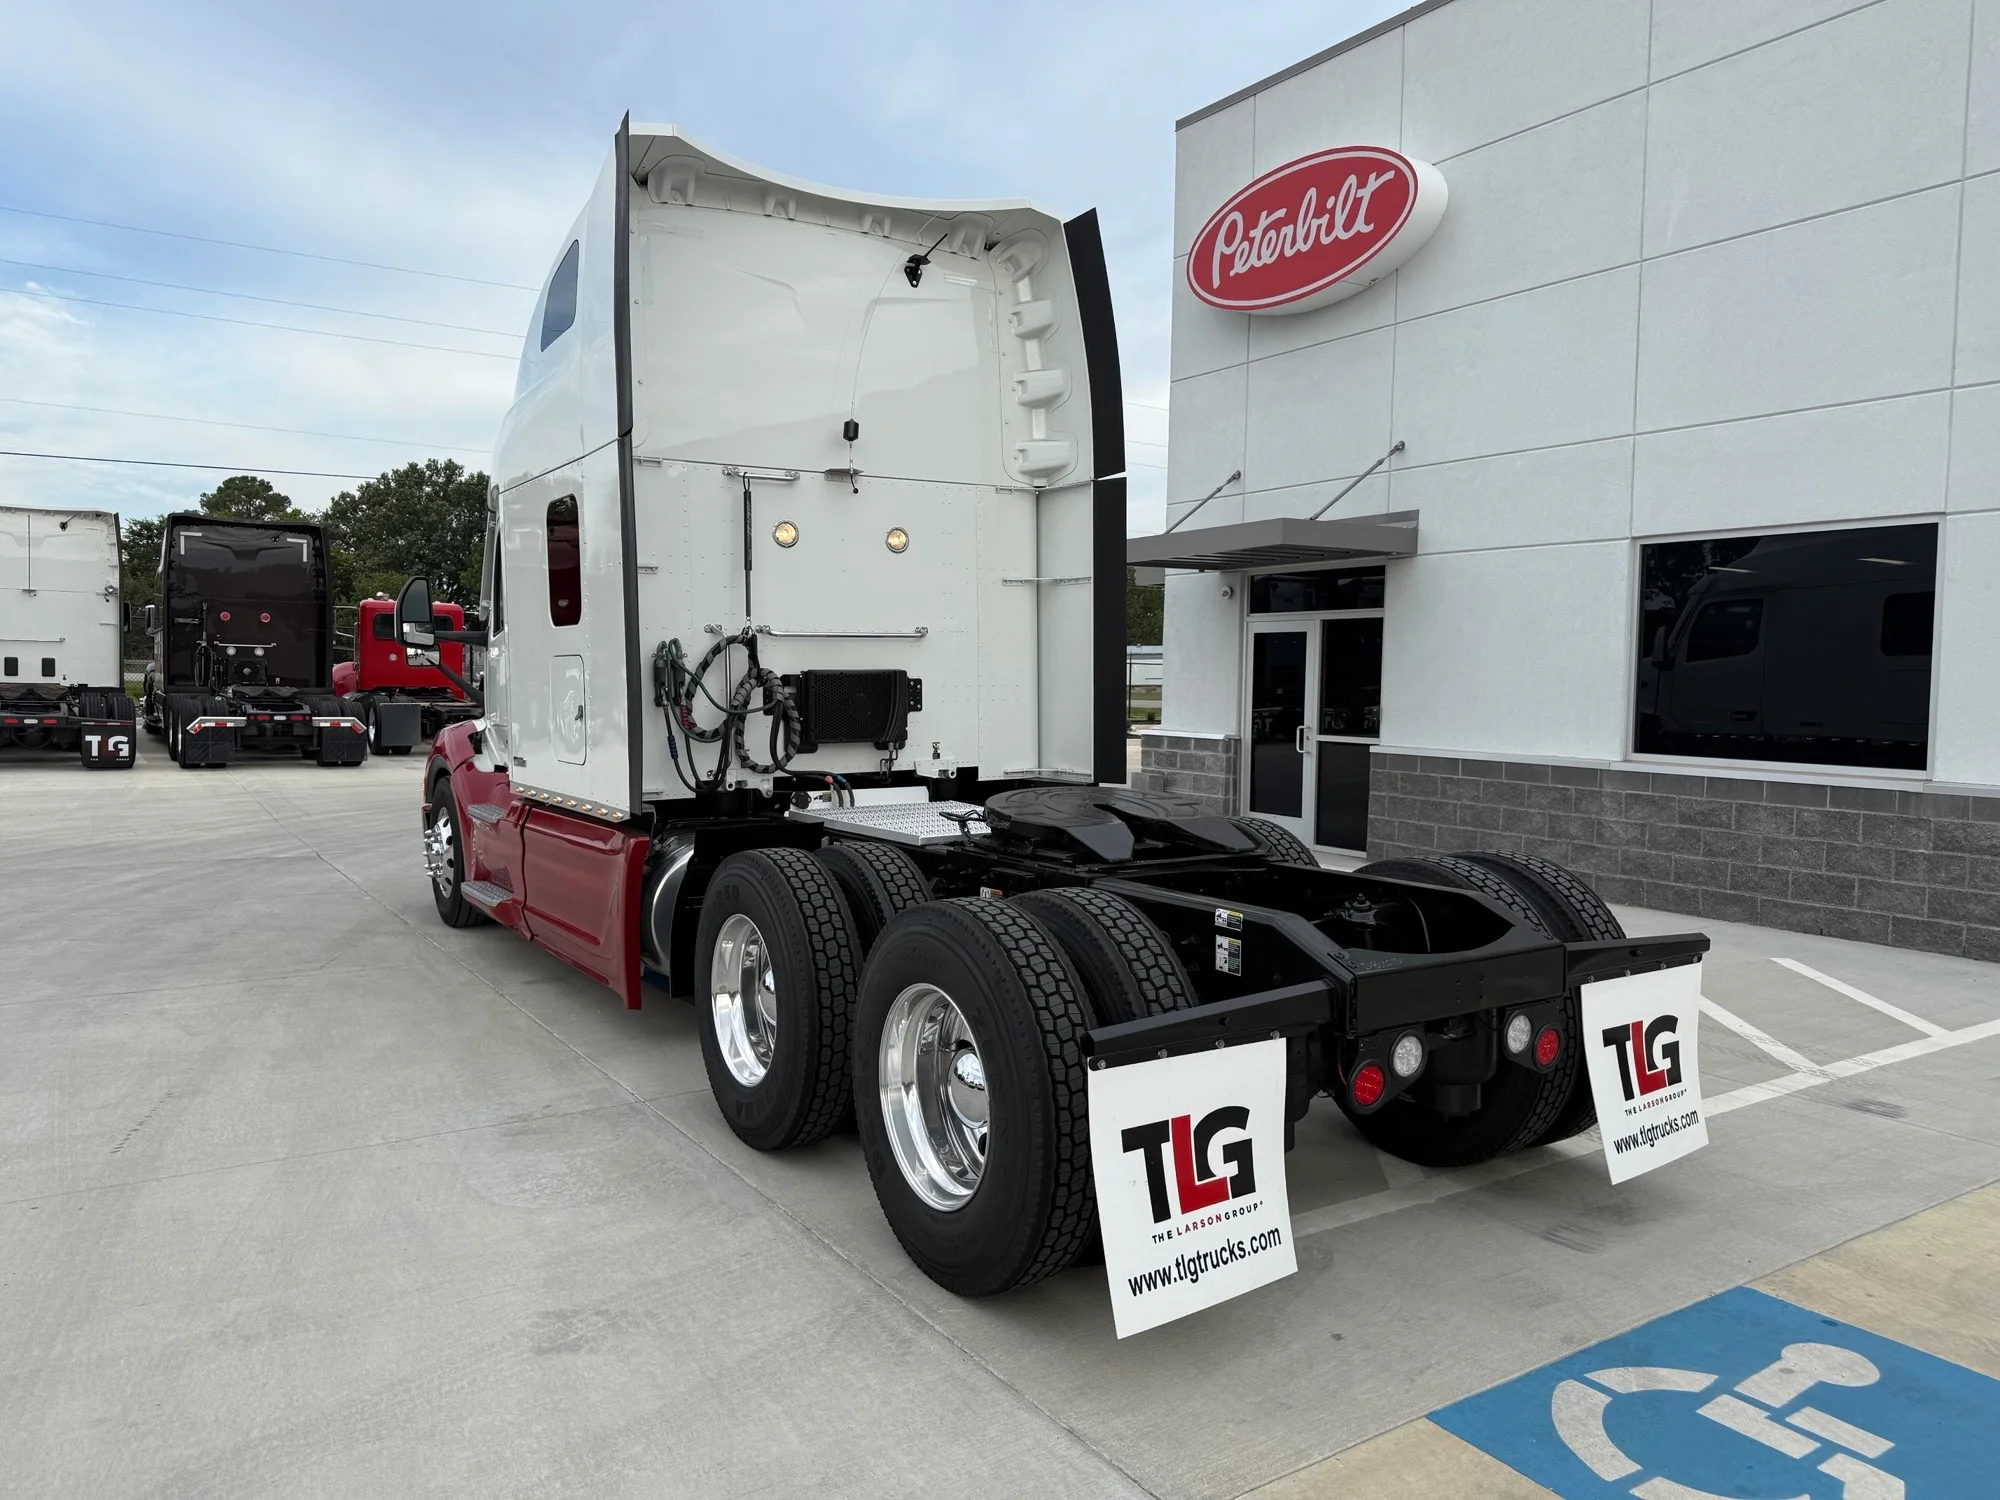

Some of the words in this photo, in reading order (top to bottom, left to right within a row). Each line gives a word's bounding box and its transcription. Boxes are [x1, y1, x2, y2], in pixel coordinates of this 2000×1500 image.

[1212, 170, 1395, 289] Peterbilt
[1602, 1014, 1682, 1102] TLG
[1613, 1109, 1699, 1155] www.tlgtrucks.com
[1625, 1106, 1637, 1116] THE
[1121, 1105, 1257, 1225] TLG
[1127, 1227, 1283, 1297] www.tlgtrucks.com
[1152, 1229, 1173, 1244] THE
